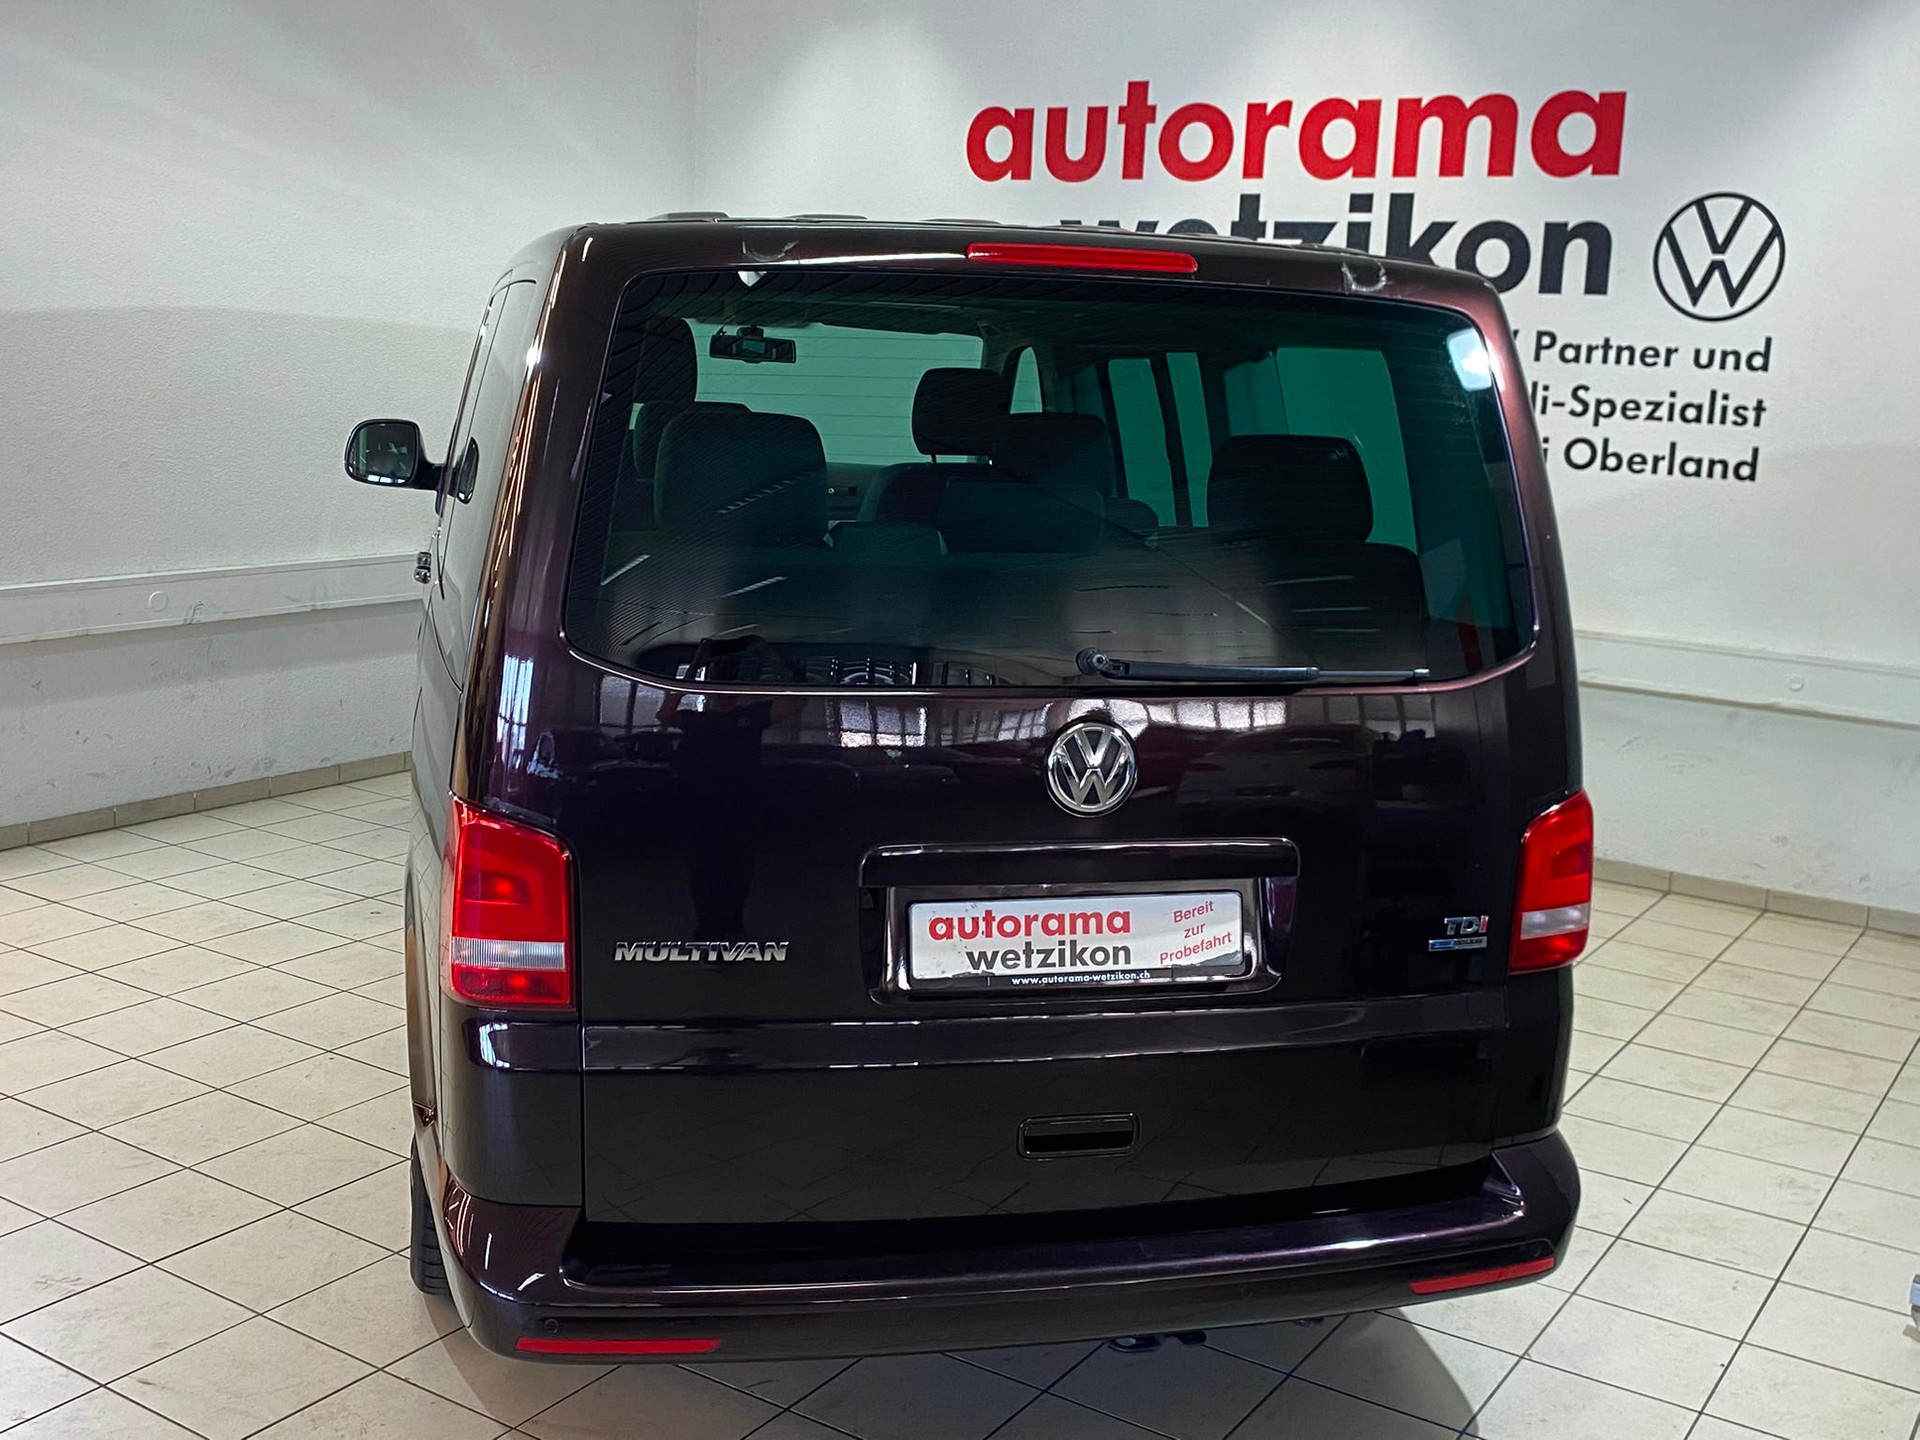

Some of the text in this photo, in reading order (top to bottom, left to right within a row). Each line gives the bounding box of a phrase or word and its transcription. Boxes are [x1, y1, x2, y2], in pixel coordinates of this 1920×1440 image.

[966, 80, 1627, 183] autorama
[1533, 330, 1772, 373] Partner und
[1563, 437, 1760, 482] Oberland
[928, 909, 1131, 941] autorama
[1172, 900, 1215, 924] Bereit
[1183, 922, 1206, 940] zur
[613, 940, 790, 962] MULTIVAN
[966, 939, 1132, 971] wetzikon
[1159, 930, 1233, 966] Probefahrt
[1011, 970, 1151, 986] www.autorama-wetzikon.ch
